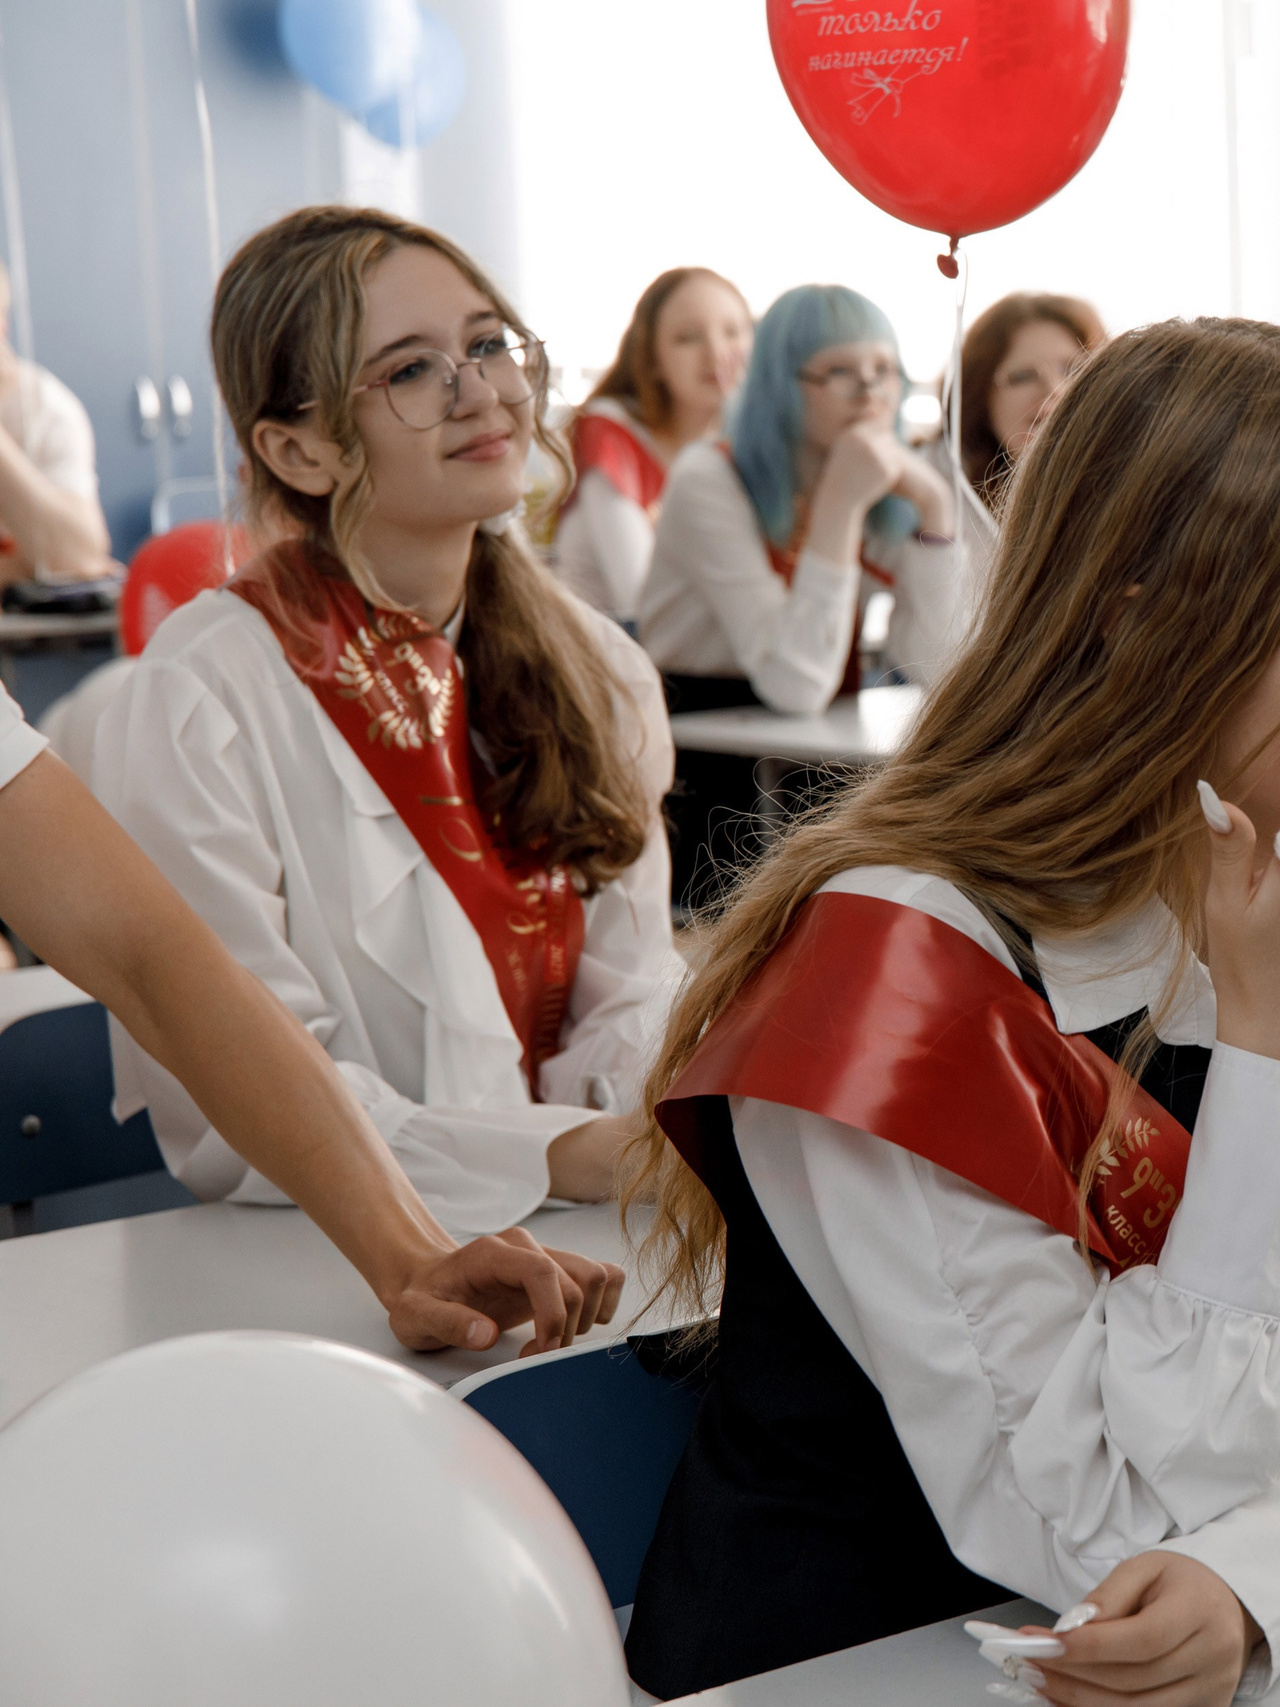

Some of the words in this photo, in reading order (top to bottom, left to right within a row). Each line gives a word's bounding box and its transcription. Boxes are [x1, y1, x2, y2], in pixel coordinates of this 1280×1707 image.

[818, 0, 942, 37] только
[808, 37, 969, 74] начинается!
[1106, 1204, 1147, 1255] класс
